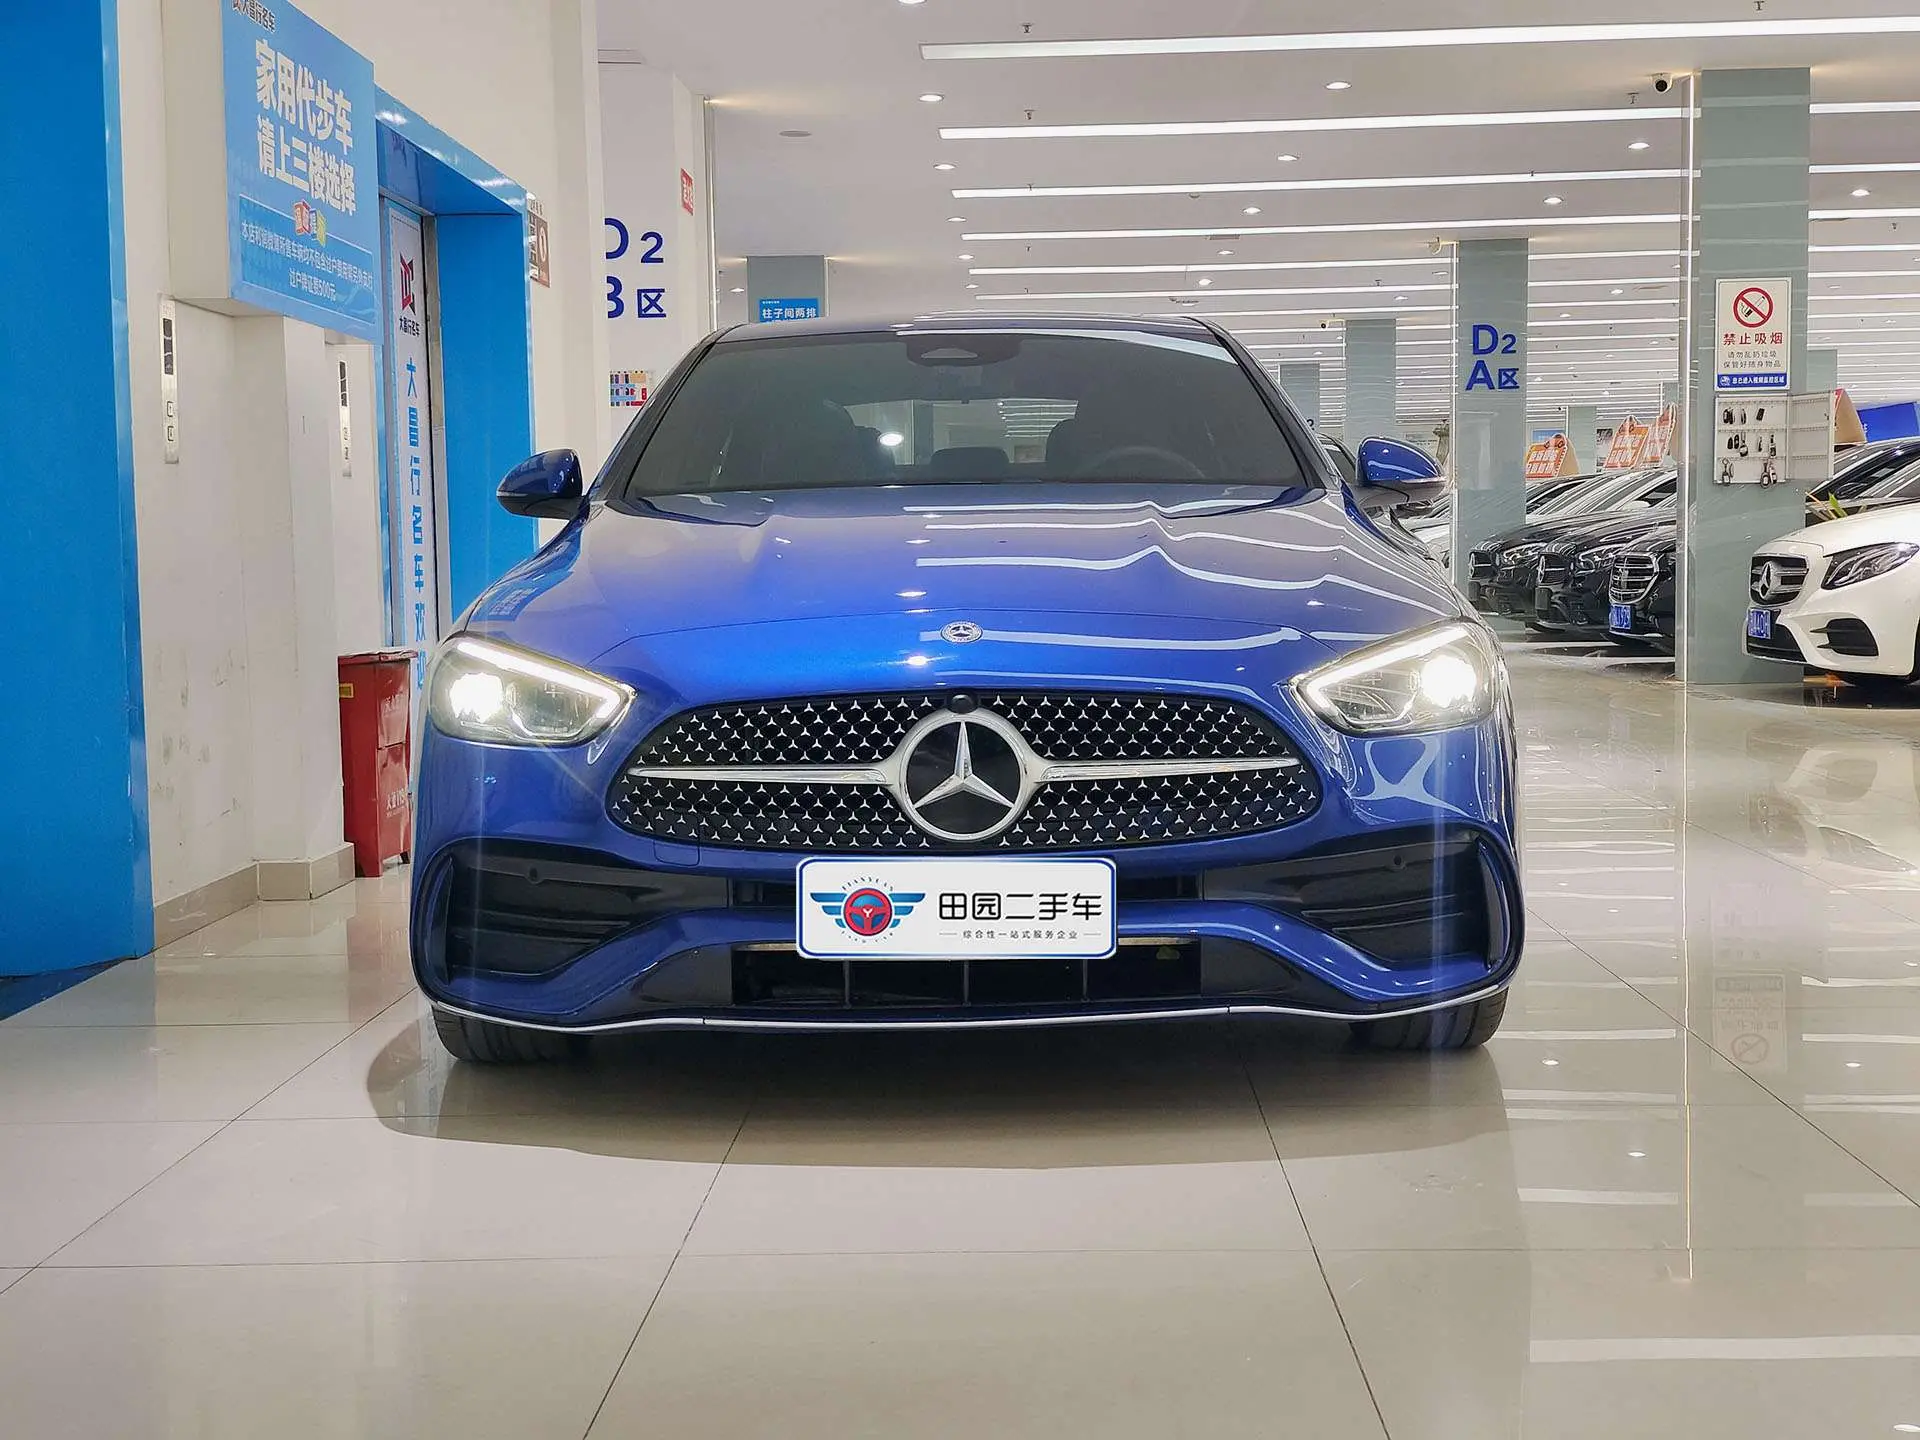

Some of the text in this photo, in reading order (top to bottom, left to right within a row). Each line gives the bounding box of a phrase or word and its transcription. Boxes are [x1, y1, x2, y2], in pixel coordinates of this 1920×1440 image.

[256, 38, 353, 155] 家用代步车
[257, 114, 357, 216] 请上三楼选择
[763, 307, 817, 319] 柱子间两排
[1472, 323, 1517, 356] D2
[1723, 332, 1783, 346] 禁止吸烟
[1465, 359, 1520, 391] A区
[1723, 360, 1782, 369] 保管好随身物品
[938, 892, 1102, 921] 田园二手车
[963, 929, 1078, 939] 综合性一站式服务企业
